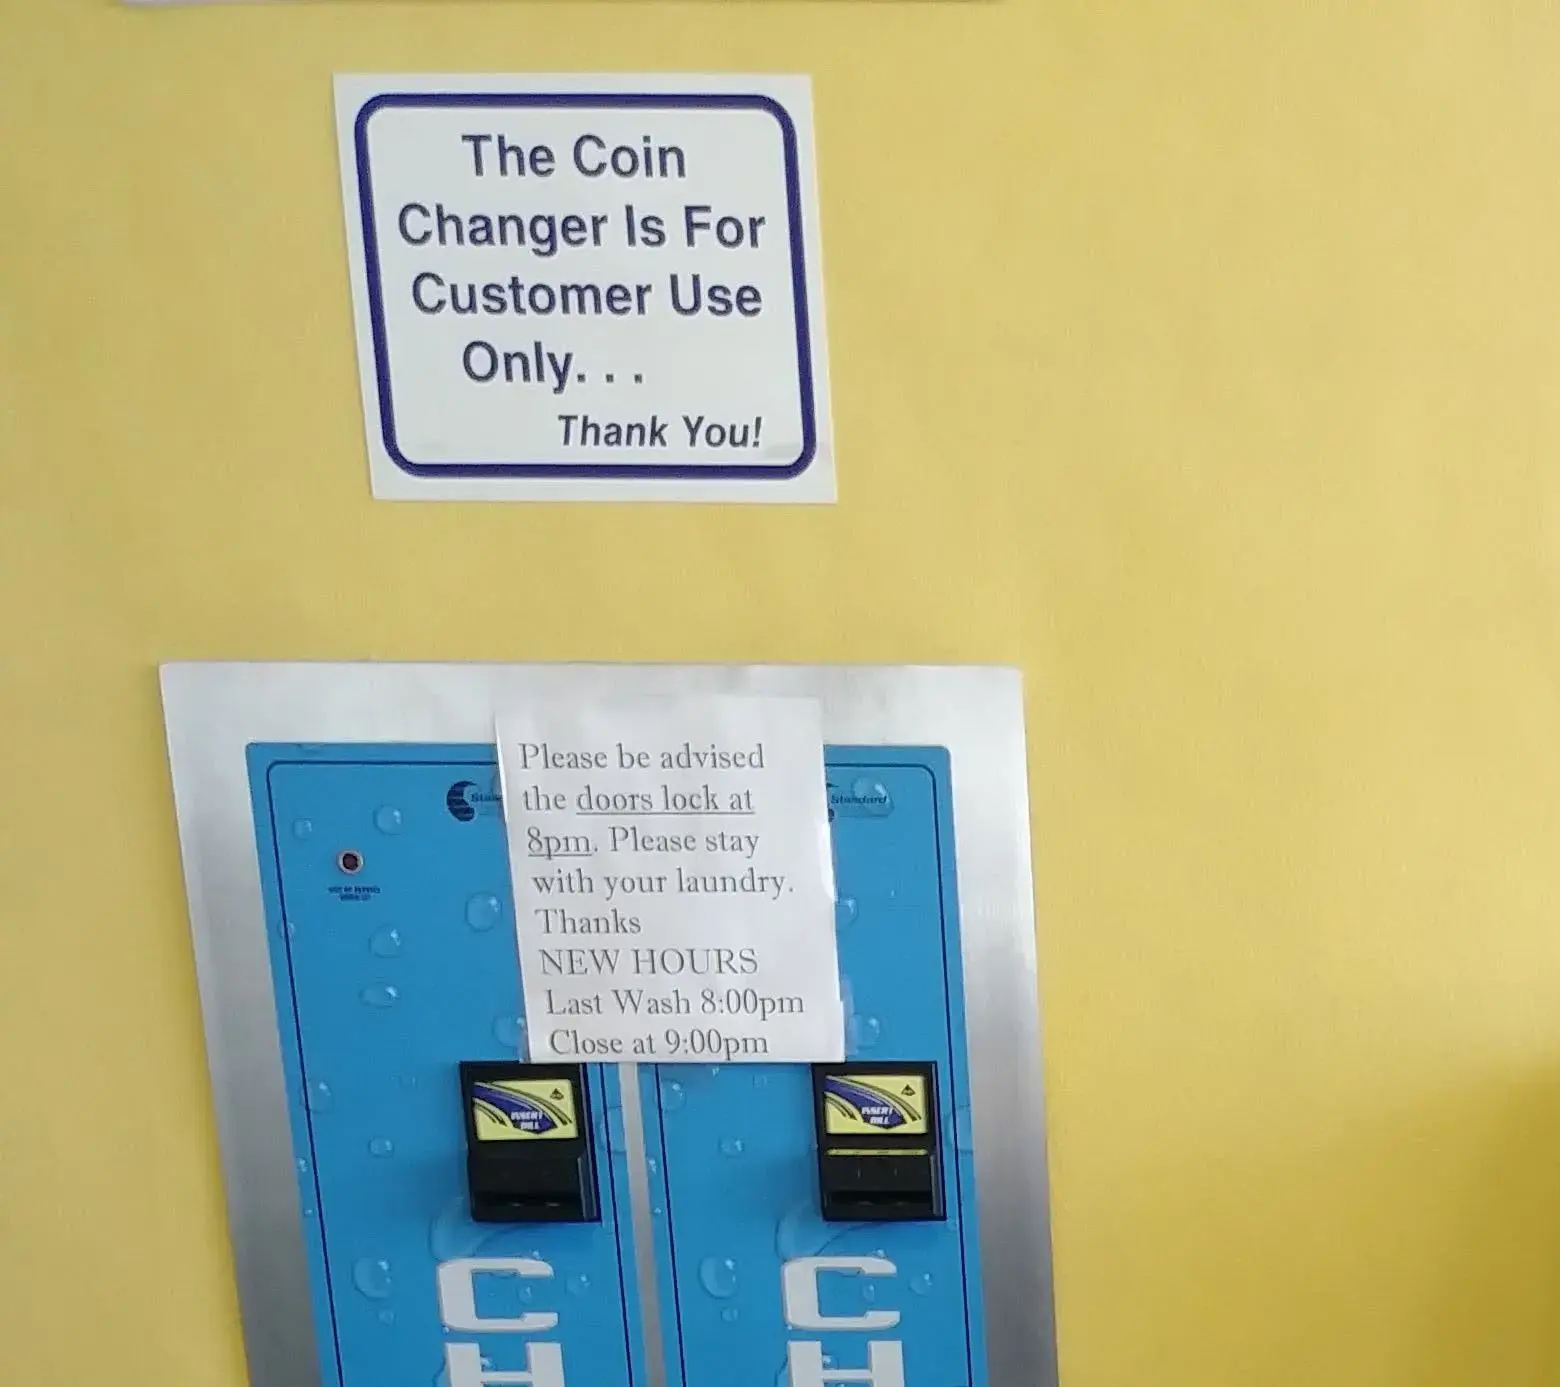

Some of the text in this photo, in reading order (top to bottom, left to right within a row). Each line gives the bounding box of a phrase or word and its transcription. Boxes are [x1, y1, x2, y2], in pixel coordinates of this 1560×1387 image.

[462, 133, 687, 179] The Coin
[397, 202, 766, 257] Changer Is For
[411, 272, 763, 319] Customer Use
[558, 414, 763, 449] Thank You!
[518, 742, 765, 771] Please be advised
[523, 784, 755, 812] the doors lock at
[526, 826, 760, 861] 8pm. Please stay
[531, 867, 794, 900] with your laundry.
[534, 909, 642, 935] Thanks
[538, 947, 759, 976] NEW HOURS
[545, 988, 805, 1021] Last Wash 8:00pm
[549, 1028, 769, 1061] Close at 9:00pm
[862, 1106, 894, 1116] INSERT
